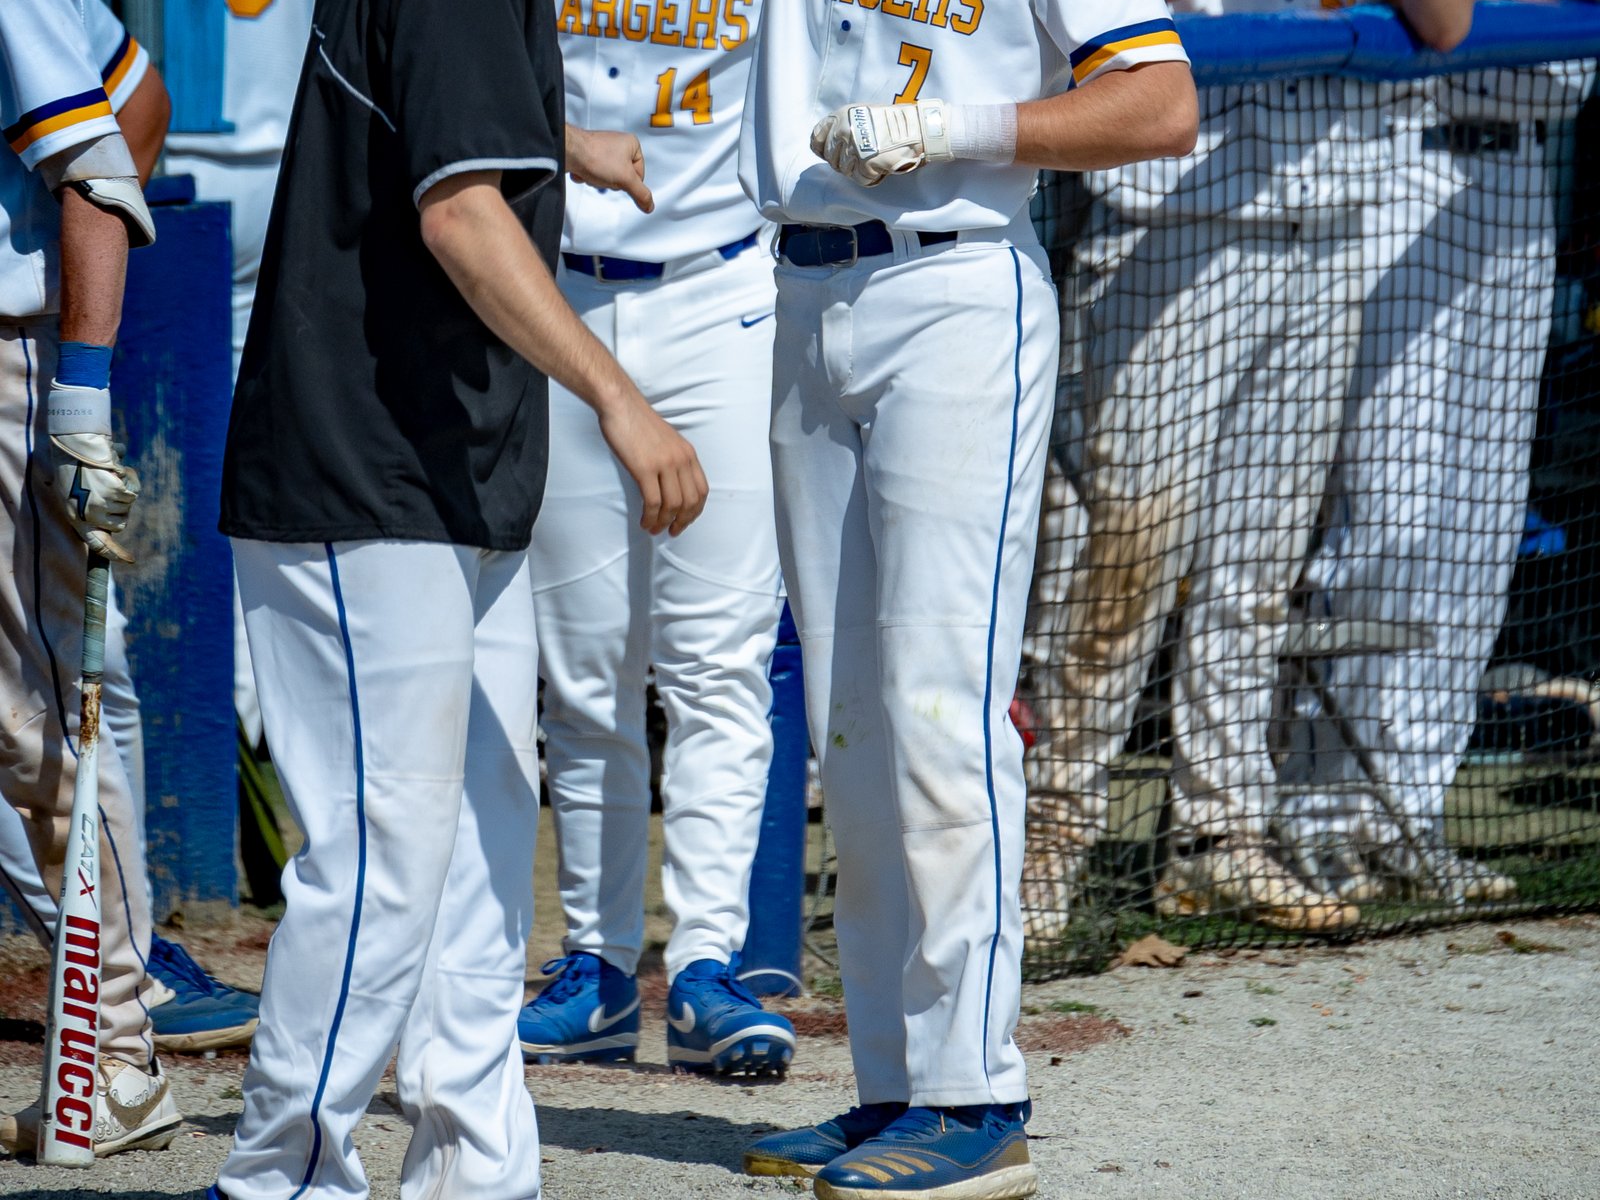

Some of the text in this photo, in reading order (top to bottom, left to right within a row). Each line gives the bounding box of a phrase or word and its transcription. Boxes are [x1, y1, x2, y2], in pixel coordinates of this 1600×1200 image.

[650, 67, 713, 128] 14
[893, 42, 933, 105] 7
[54, 914, 101, 1150] marucci
